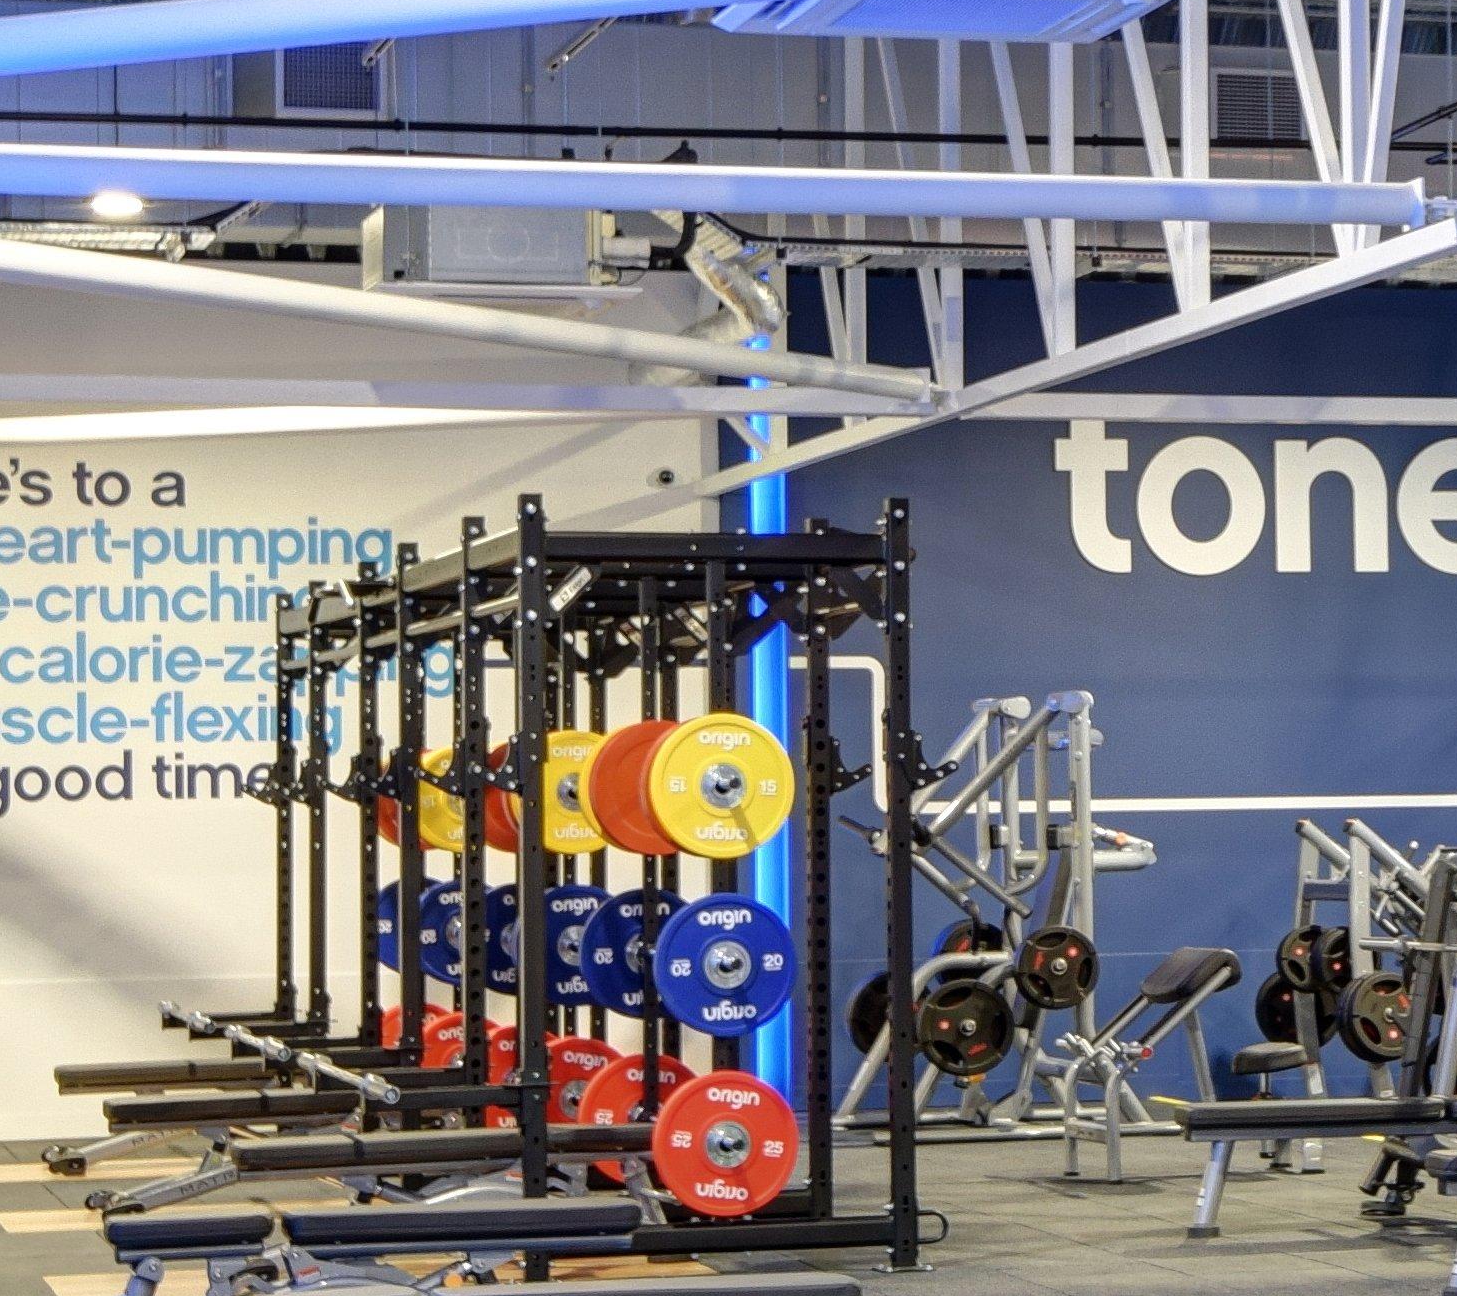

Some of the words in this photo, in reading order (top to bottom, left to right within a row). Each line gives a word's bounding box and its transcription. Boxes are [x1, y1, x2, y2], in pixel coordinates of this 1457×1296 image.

[73, 461, 131, 507] to
[150, 469, 187, 507] a
[698, 730, 752, 751] origin
[759, 779, 778, 793] 15
[696, 821, 749, 841] origin
[551, 897, 599, 916] origin
[697, 909, 752, 931] origin
[670, 961, 692, 978] 20
[762, 953, 784, 968] 20
[702, 999, 758, 1021] origin
[706, 1086, 761, 1110] origin
[762, 1140, 785, 1155] 25
[695, 1179, 749, 1202] origin
